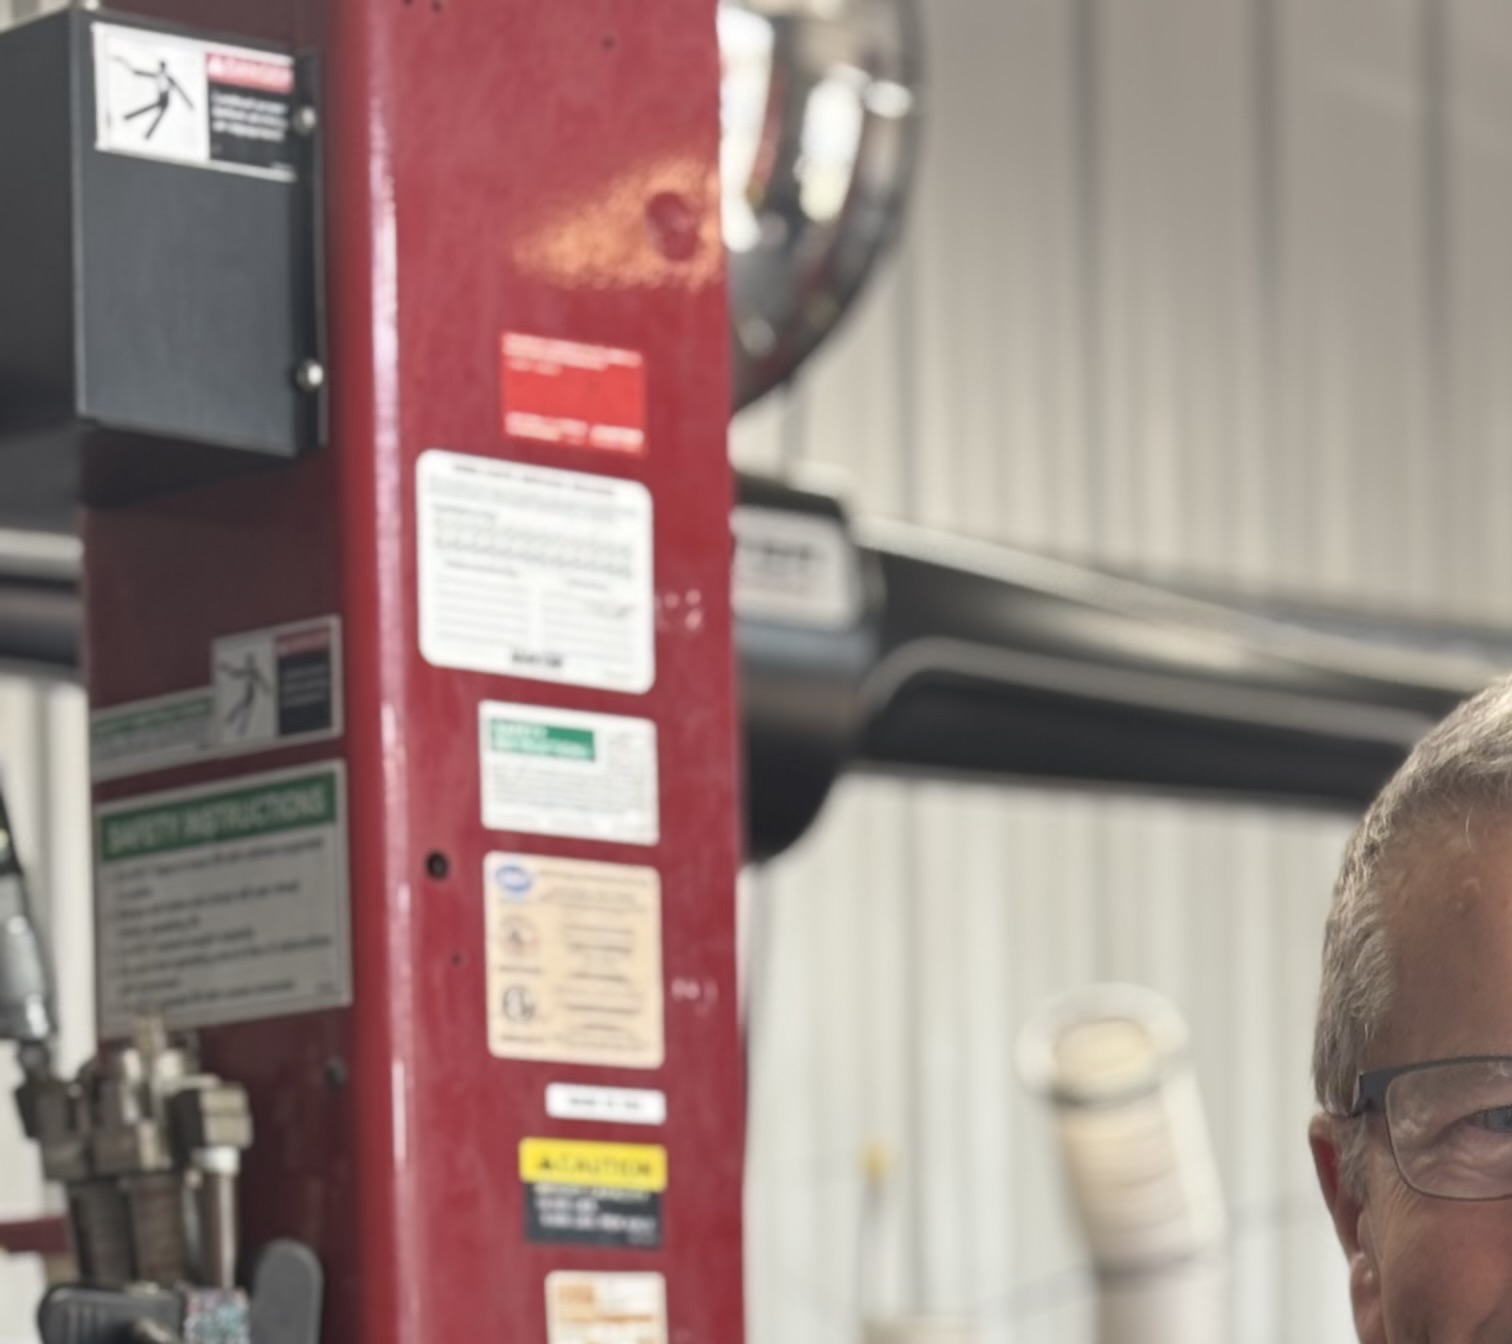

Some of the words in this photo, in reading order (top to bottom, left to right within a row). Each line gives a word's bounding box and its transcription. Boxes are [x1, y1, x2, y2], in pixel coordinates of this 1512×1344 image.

[108, 811, 179, 855] SAFETY
[184, 784, 326, 839] INSTRUCTIONS
[556, 1154, 652, 1178] CAUTION
